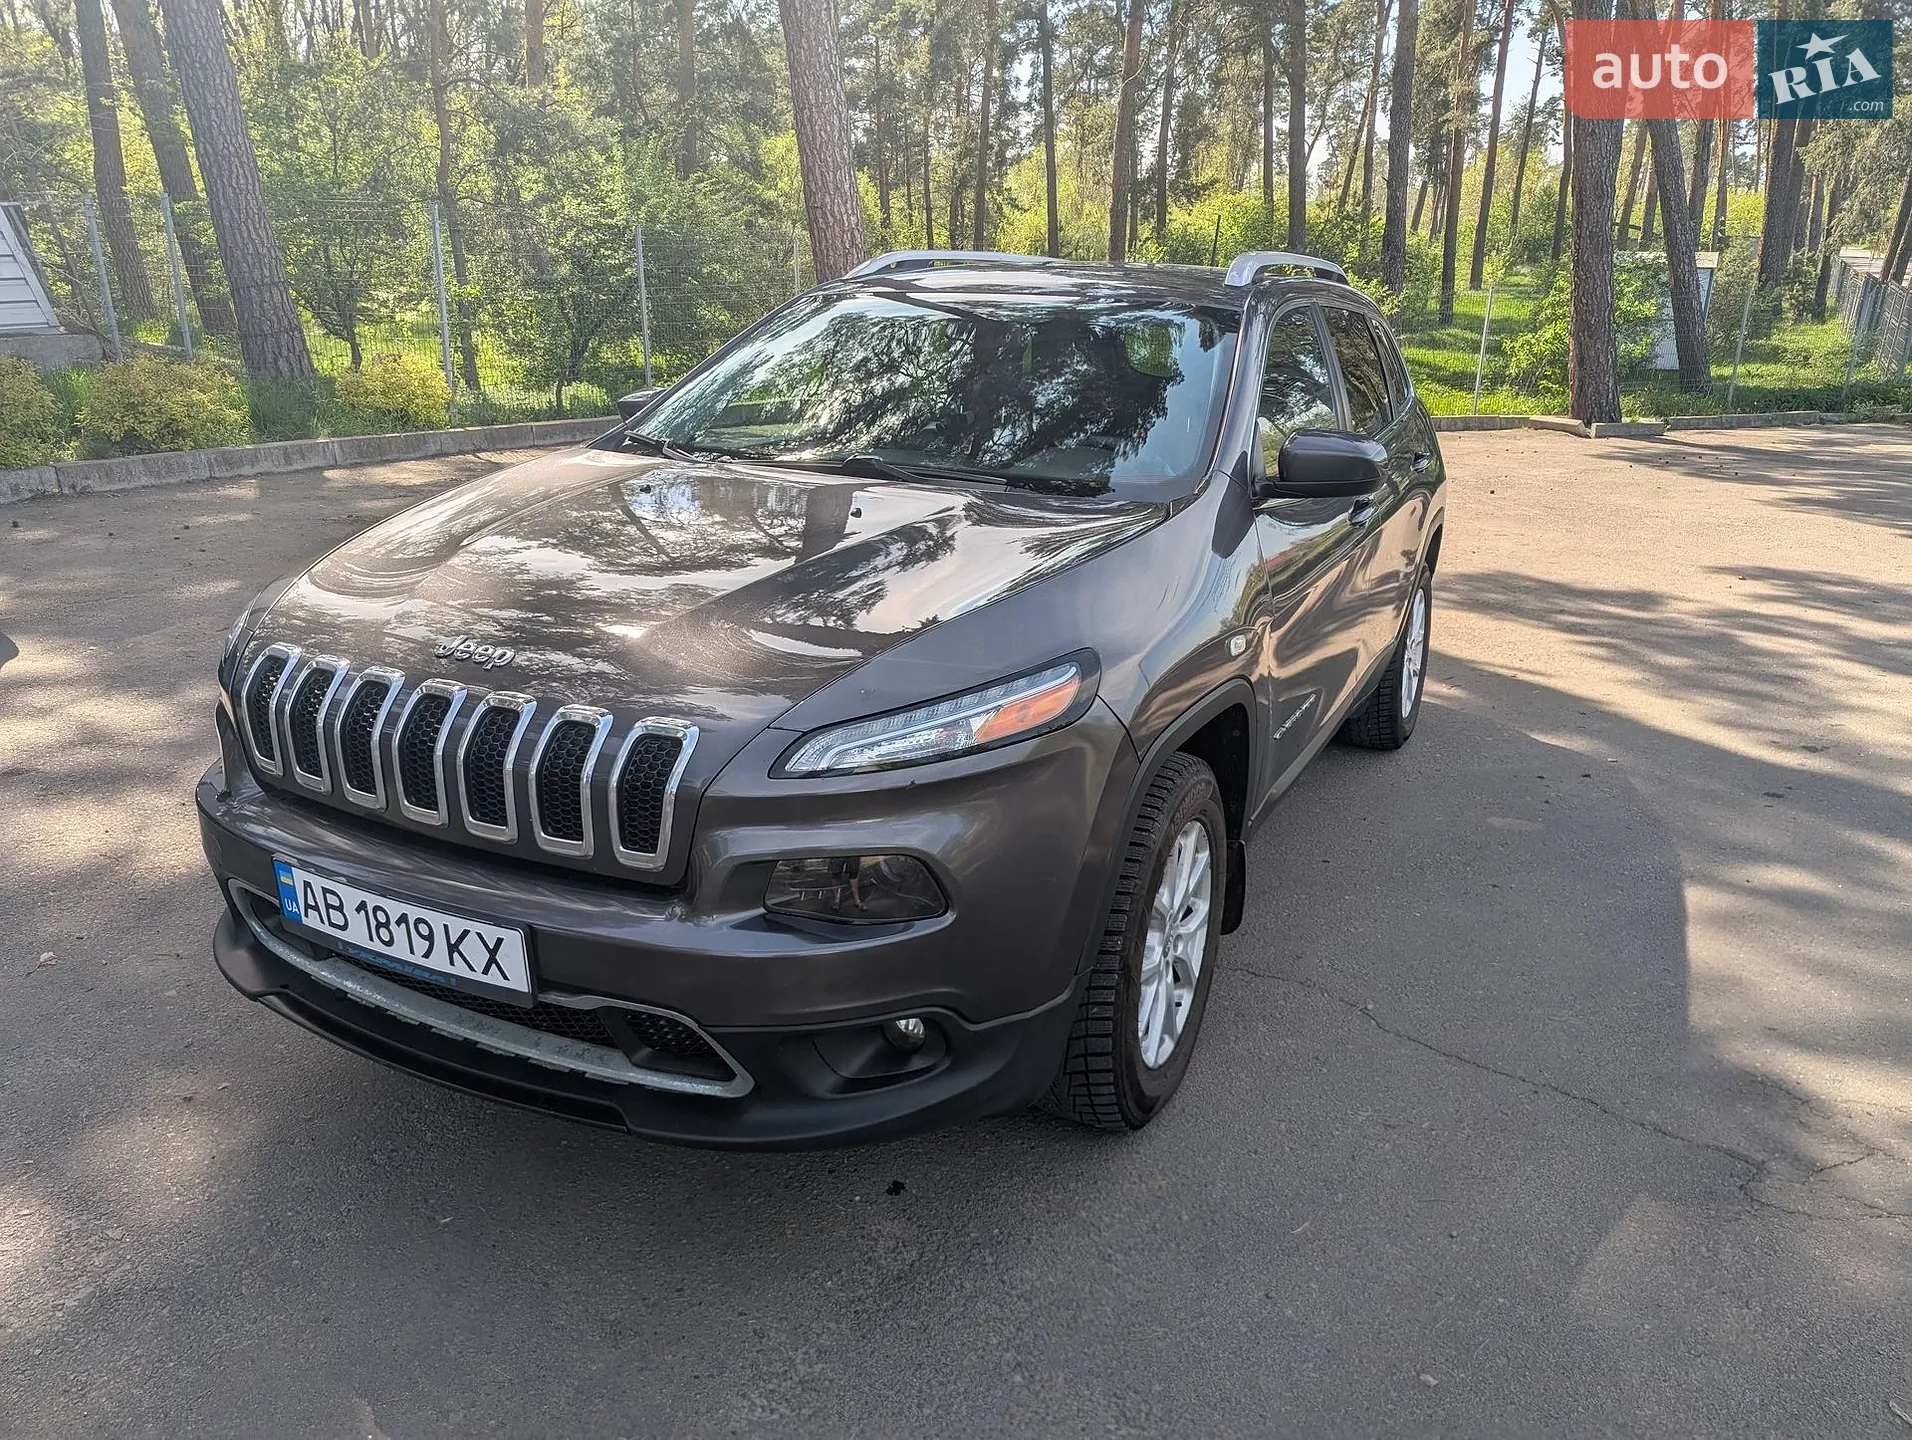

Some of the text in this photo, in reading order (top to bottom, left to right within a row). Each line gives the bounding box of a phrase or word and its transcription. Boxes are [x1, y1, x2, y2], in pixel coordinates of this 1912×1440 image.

[434, 634, 516, 671] Jeep
[284, 897, 300, 915] UA
[303, 879, 350, 932] AB
[354, 899, 435, 959] 1819
[444, 923, 510, 982] KX
